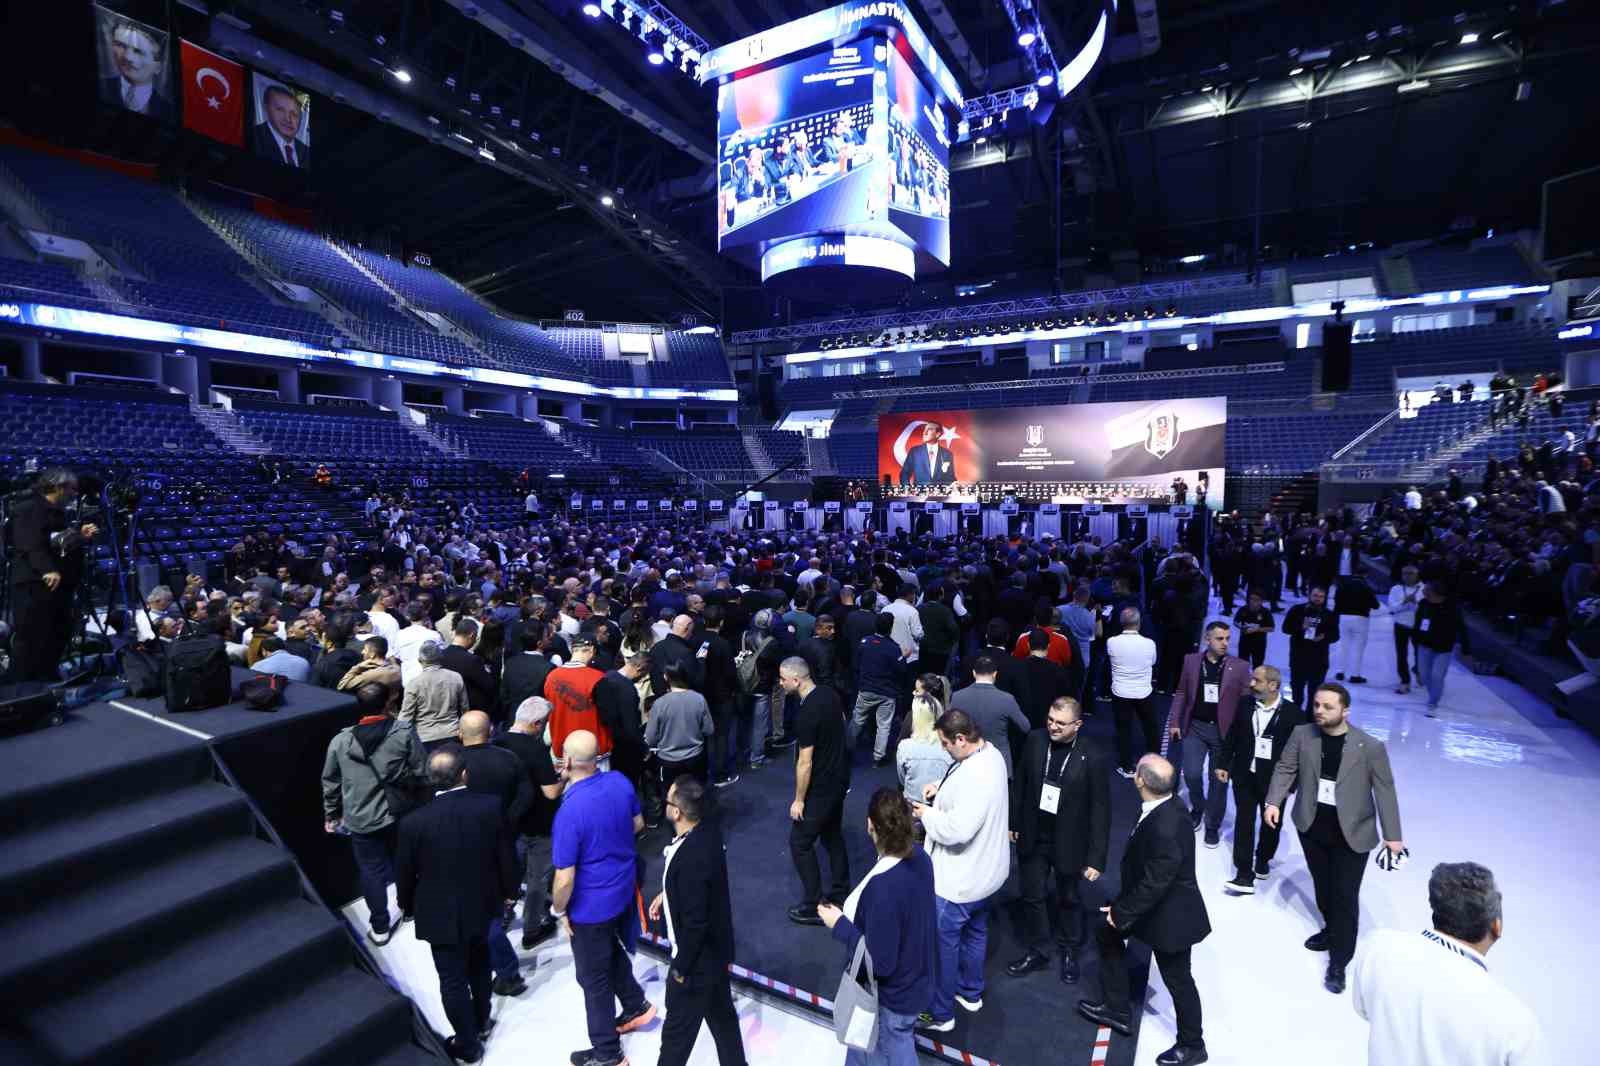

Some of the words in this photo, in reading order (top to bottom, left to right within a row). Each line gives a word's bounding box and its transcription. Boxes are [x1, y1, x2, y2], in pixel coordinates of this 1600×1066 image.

[414, 255, 431, 266] 403
[566, 312, 584, 321] 402
[411, 478, 429, 488] 105
